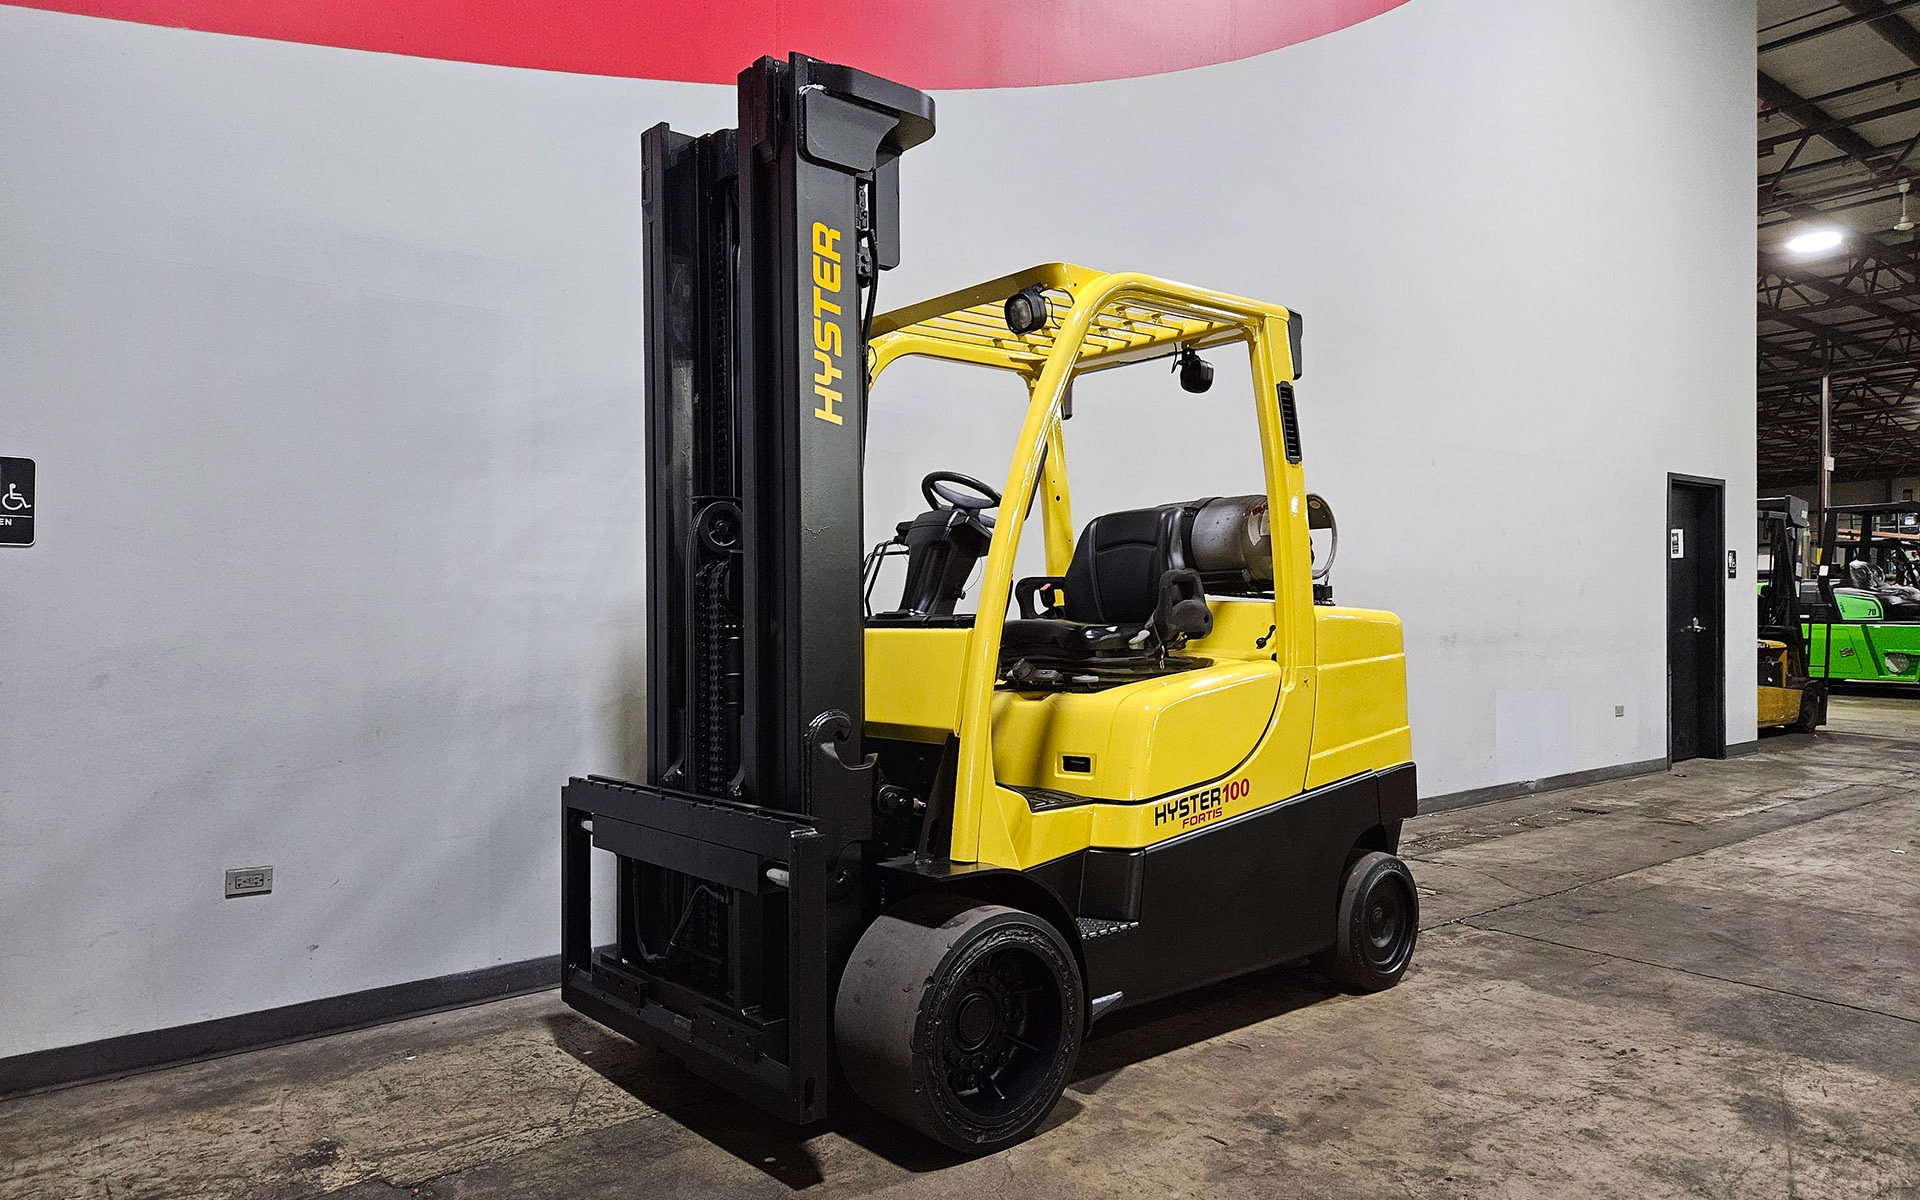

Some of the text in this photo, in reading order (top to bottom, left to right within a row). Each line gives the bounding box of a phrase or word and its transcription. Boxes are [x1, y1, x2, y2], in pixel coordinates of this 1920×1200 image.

[813, 222, 843, 426] HYSTER
[1155, 778, 1250, 826] HYSTER 100
[1182, 807, 1223, 829] FORTIS
